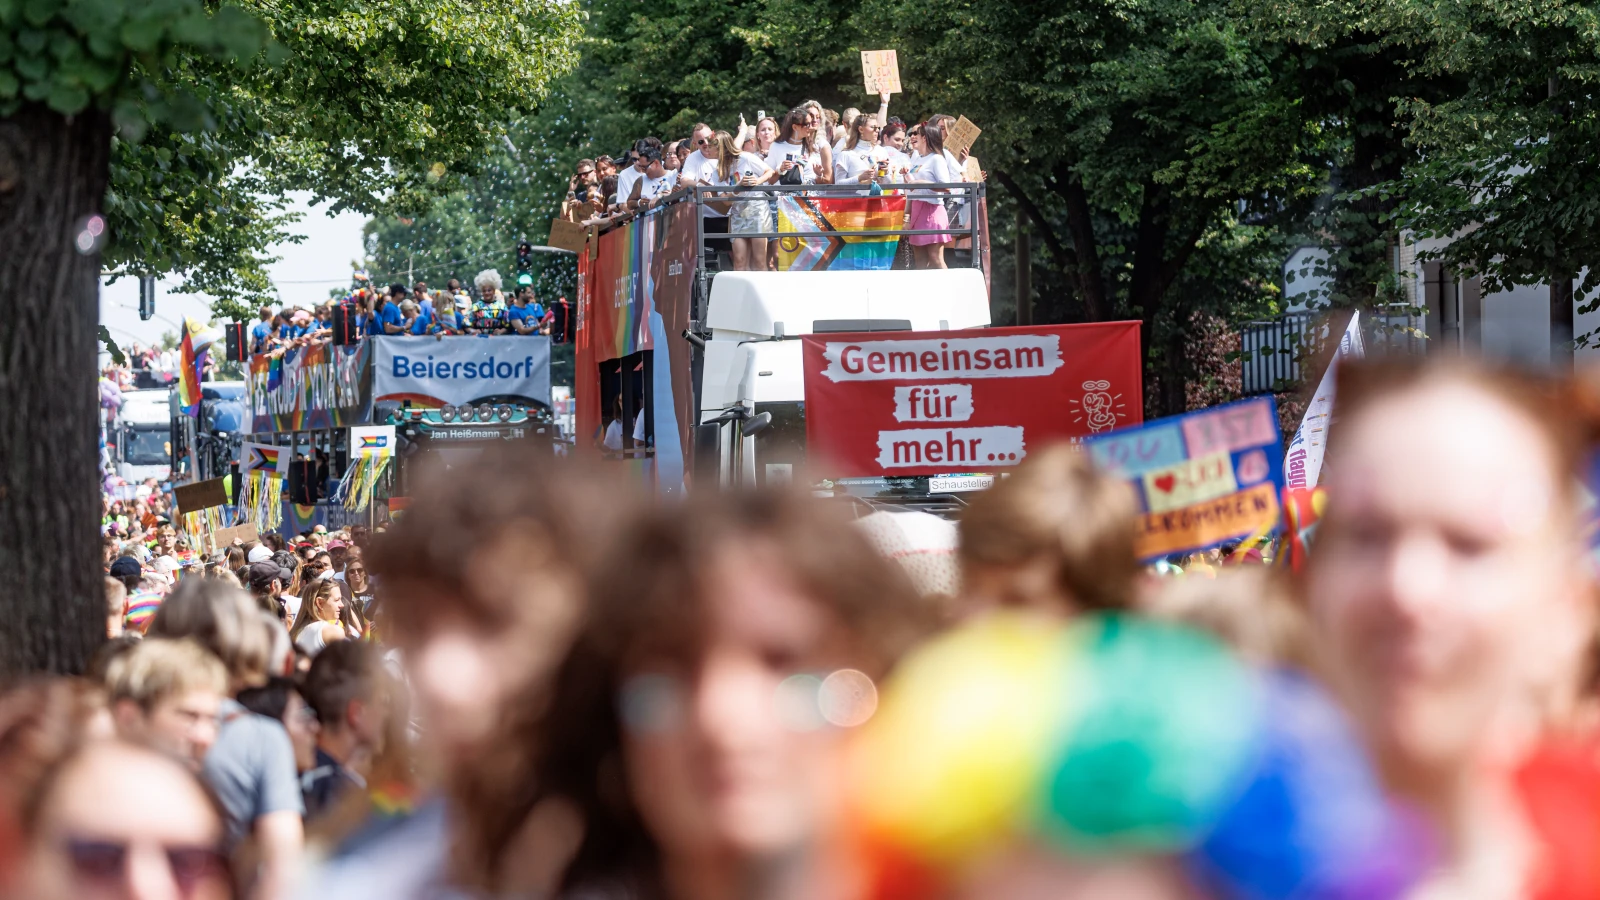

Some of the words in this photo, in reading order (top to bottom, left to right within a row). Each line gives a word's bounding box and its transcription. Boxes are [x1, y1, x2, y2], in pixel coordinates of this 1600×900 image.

[392, 355, 533, 379] Beiersdorf
[840, 342, 1044, 374] Gemeinsam
[908, 387, 958, 419] für
[430, 430, 447, 439] Jan
[450, 429, 500, 439] Heißmann
[892, 431, 1016, 463] mehr...
[931, 479, 992, 490] Schausteller
